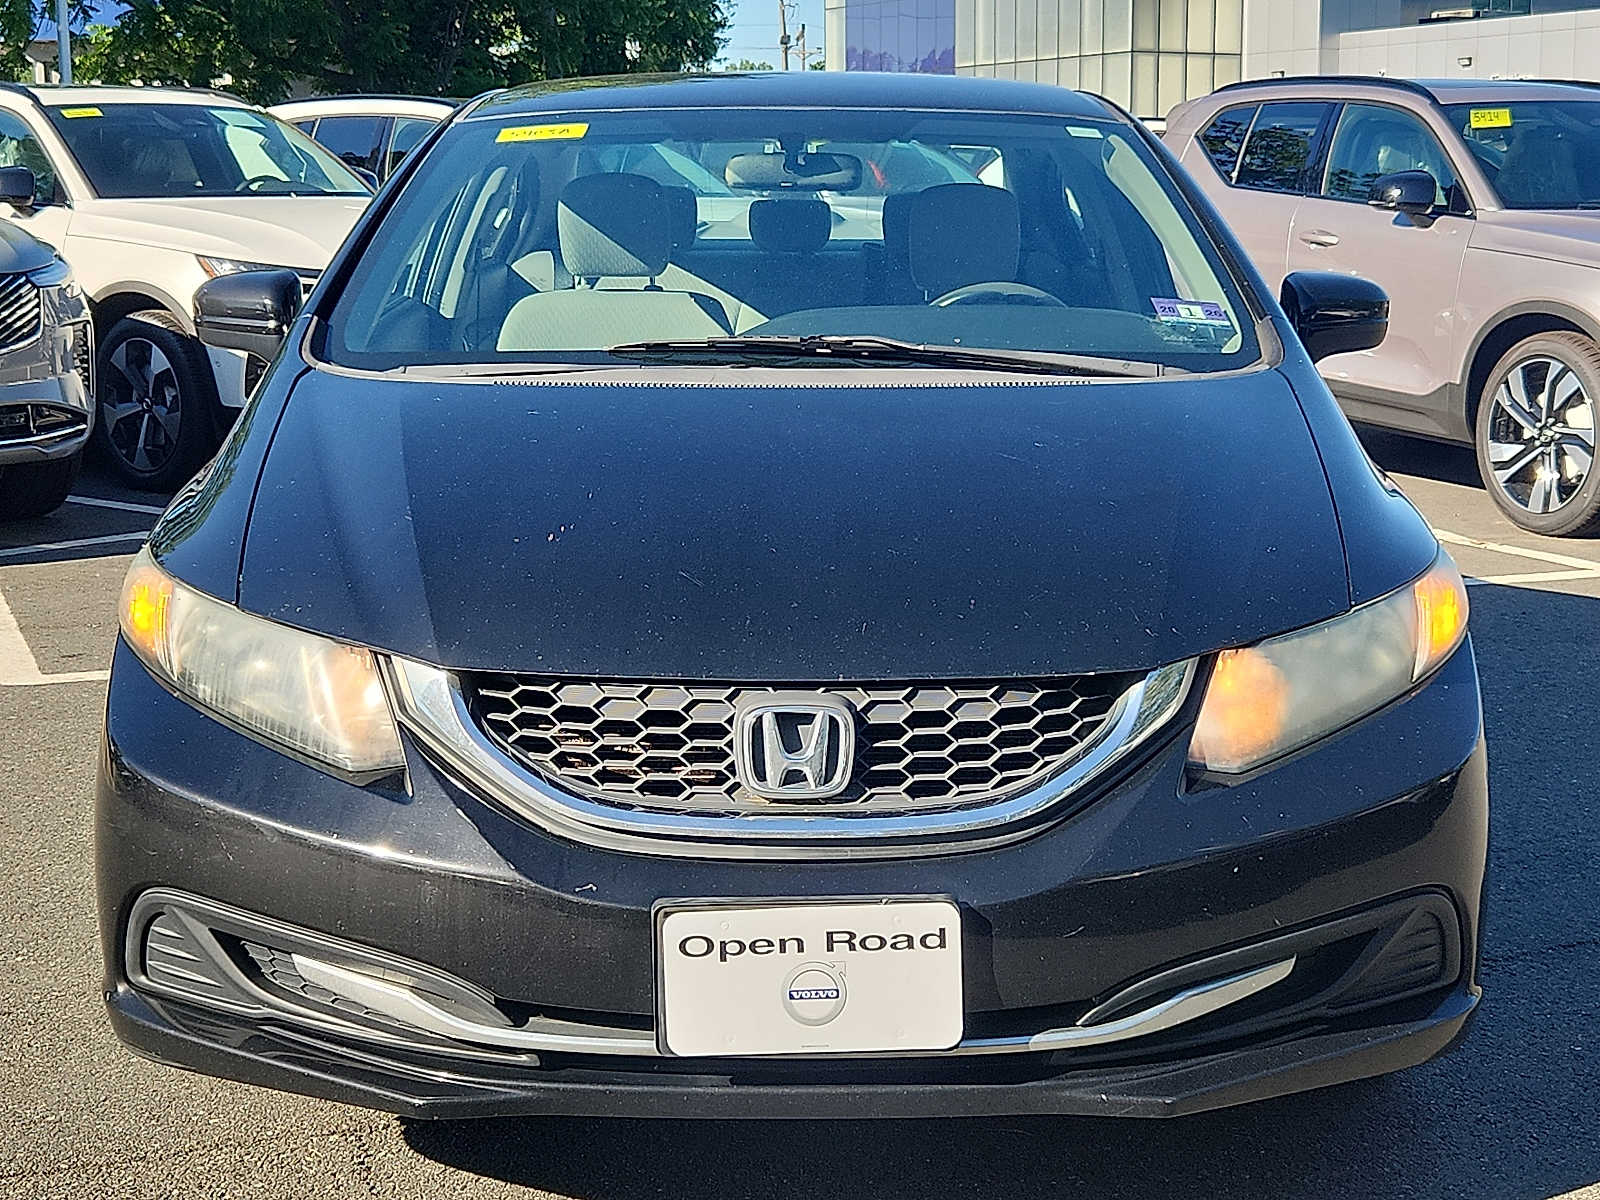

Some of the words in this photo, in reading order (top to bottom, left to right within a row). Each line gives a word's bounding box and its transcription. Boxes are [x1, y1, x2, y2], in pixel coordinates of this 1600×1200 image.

[1160, 305, 1176, 314] 20
[678, 935, 805, 962] Open
[825, 927, 947, 953] Road
[790, 990, 838, 999] VOLVO
